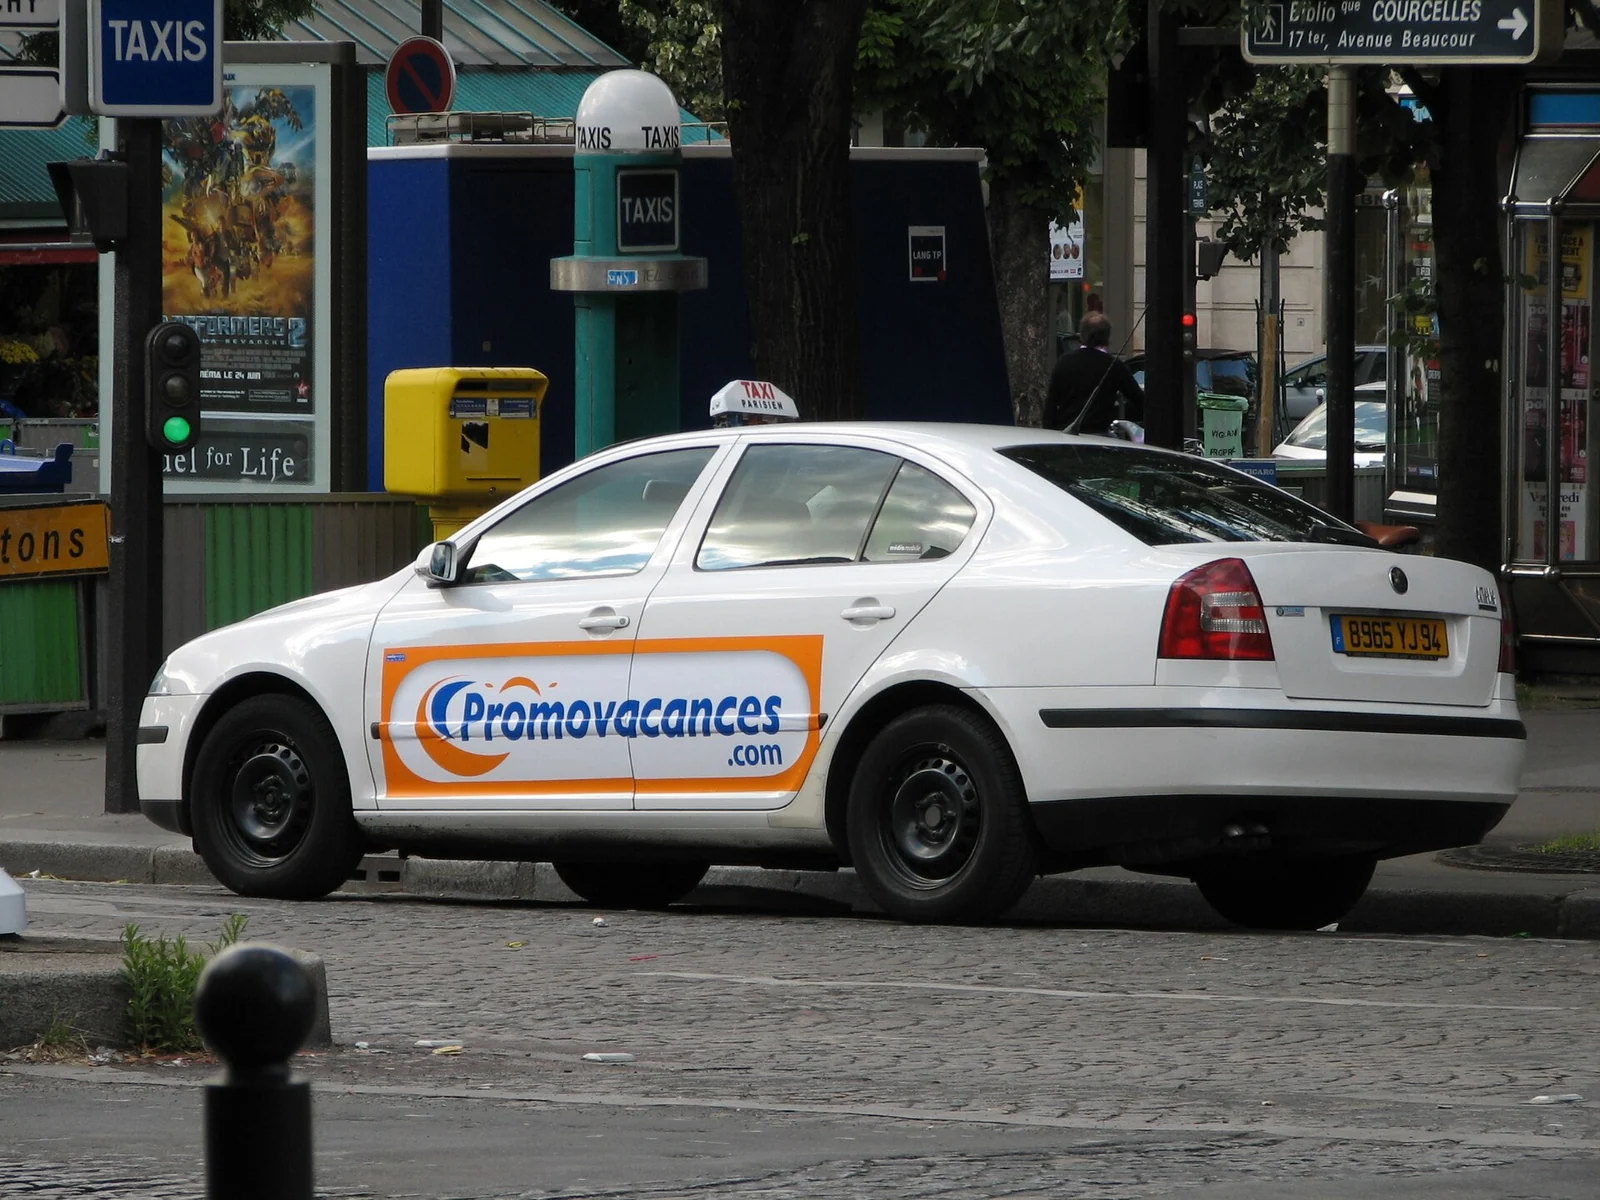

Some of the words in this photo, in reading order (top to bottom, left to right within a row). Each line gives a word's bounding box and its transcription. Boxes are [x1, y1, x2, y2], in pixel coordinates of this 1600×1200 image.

[1372, 0, 1481, 22] COURCELLES
[108, 19, 208, 62] TAXIS
[1337, 30, 1393, 48] Avenue
[1402, 30, 1477, 48] Beaucour
[577, 126, 612, 150] TAXIS
[641, 125, 680, 149] TAXIS
[622, 196, 674, 224] TAXIS
[912, 250, 931, 260] LANG
[932, 250, 942, 260] TP
[162, 315, 286, 337] SFORMERS
[288, 316, 307, 347] 2
[223, 371, 233, 379] LE
[235, 371, 245, 379] 24
[247, 371, 261, 380] JUIN
[740, 381, 775, 400] TAXI
[741, 399, 784, 411] PARISIEN
[206, 446, 233, 469] for
[240, 447, 295, 482] Life
[1348, 619, 1394, 649] 8965
[1397, 622, 1418, 650] YJ
[1420, 623, 1442, 651] 94
[462, 692, 783, 742] Promovacances
[728, 744, 783, 767] .com
